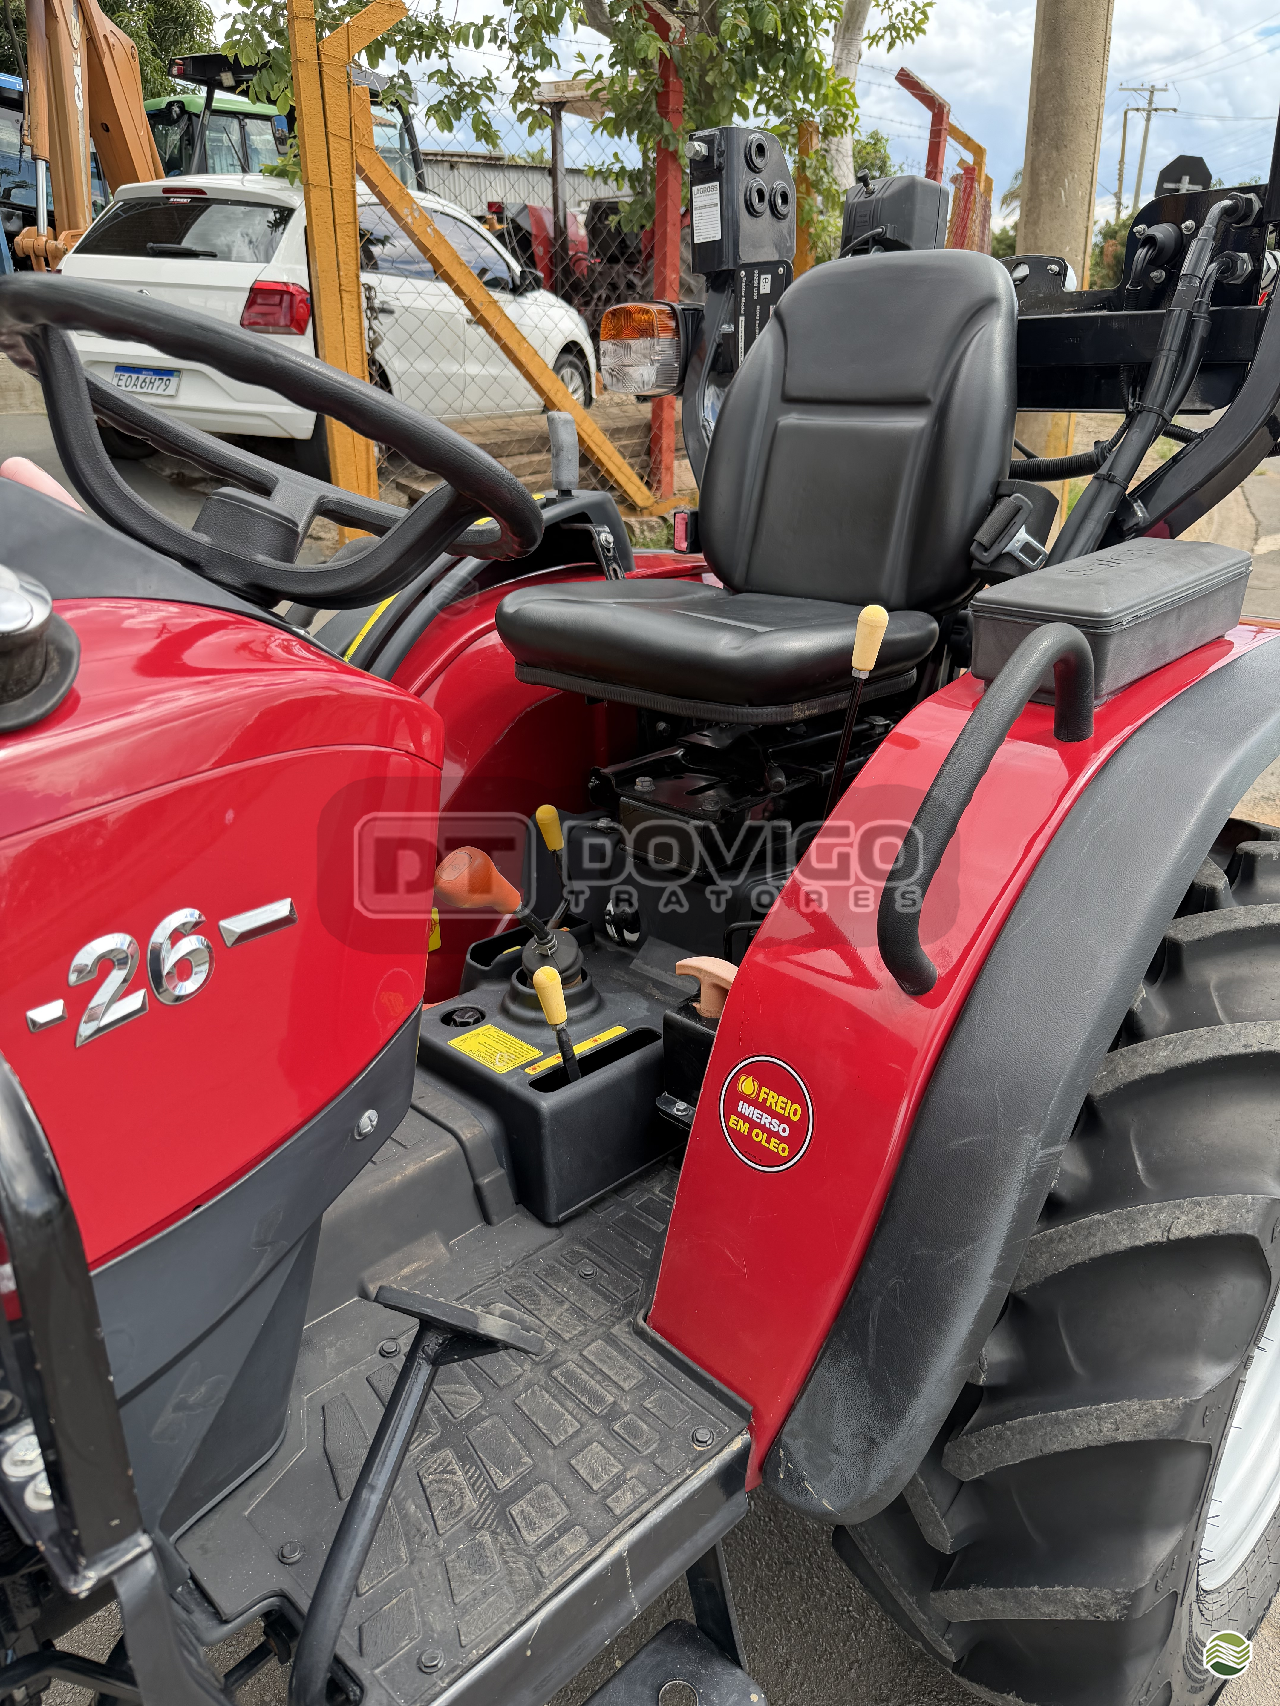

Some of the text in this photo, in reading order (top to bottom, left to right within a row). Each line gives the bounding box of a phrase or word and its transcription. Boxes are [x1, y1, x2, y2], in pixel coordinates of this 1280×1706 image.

[116, 373, 172, 393] EOA6H79
[737, 1100, 790, 1137] IMERSO
[758, 1086, 802, 1122] FREIO
[728, 1115, 750, 1136] EM
[751, 1128, 789, 1157] OLEO
